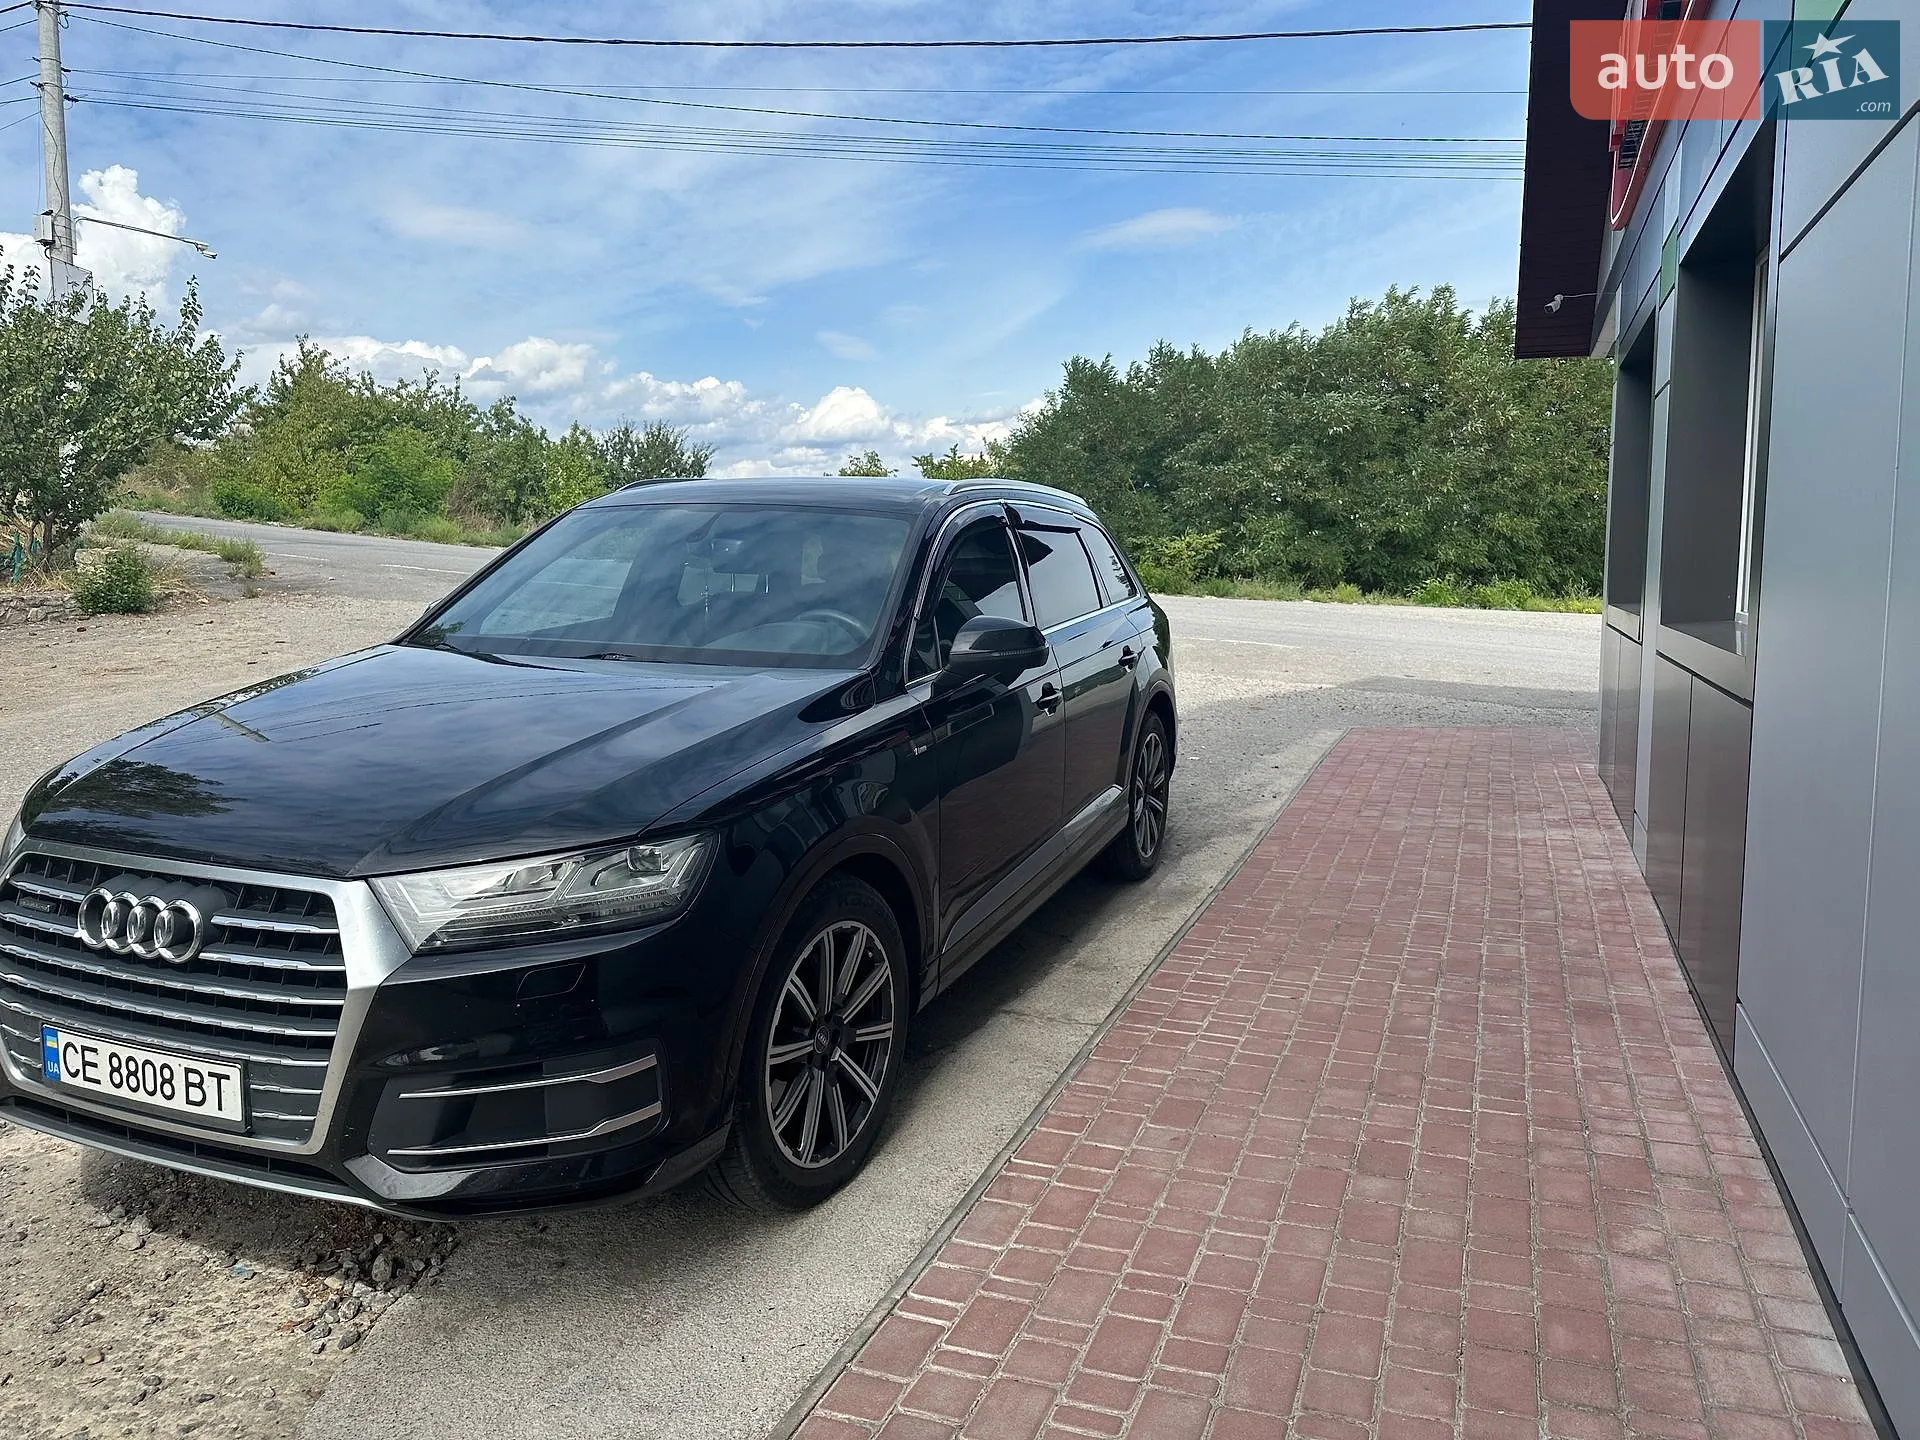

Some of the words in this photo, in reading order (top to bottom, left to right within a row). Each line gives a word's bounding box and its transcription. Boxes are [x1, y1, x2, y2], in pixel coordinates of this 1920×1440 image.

[47, 1061, 60, 1074] UA
[62, 1042, 101, 1084] CE
[108, 1053, 176, 1101] 8808
[186, 1068, 230, 1111] BT
